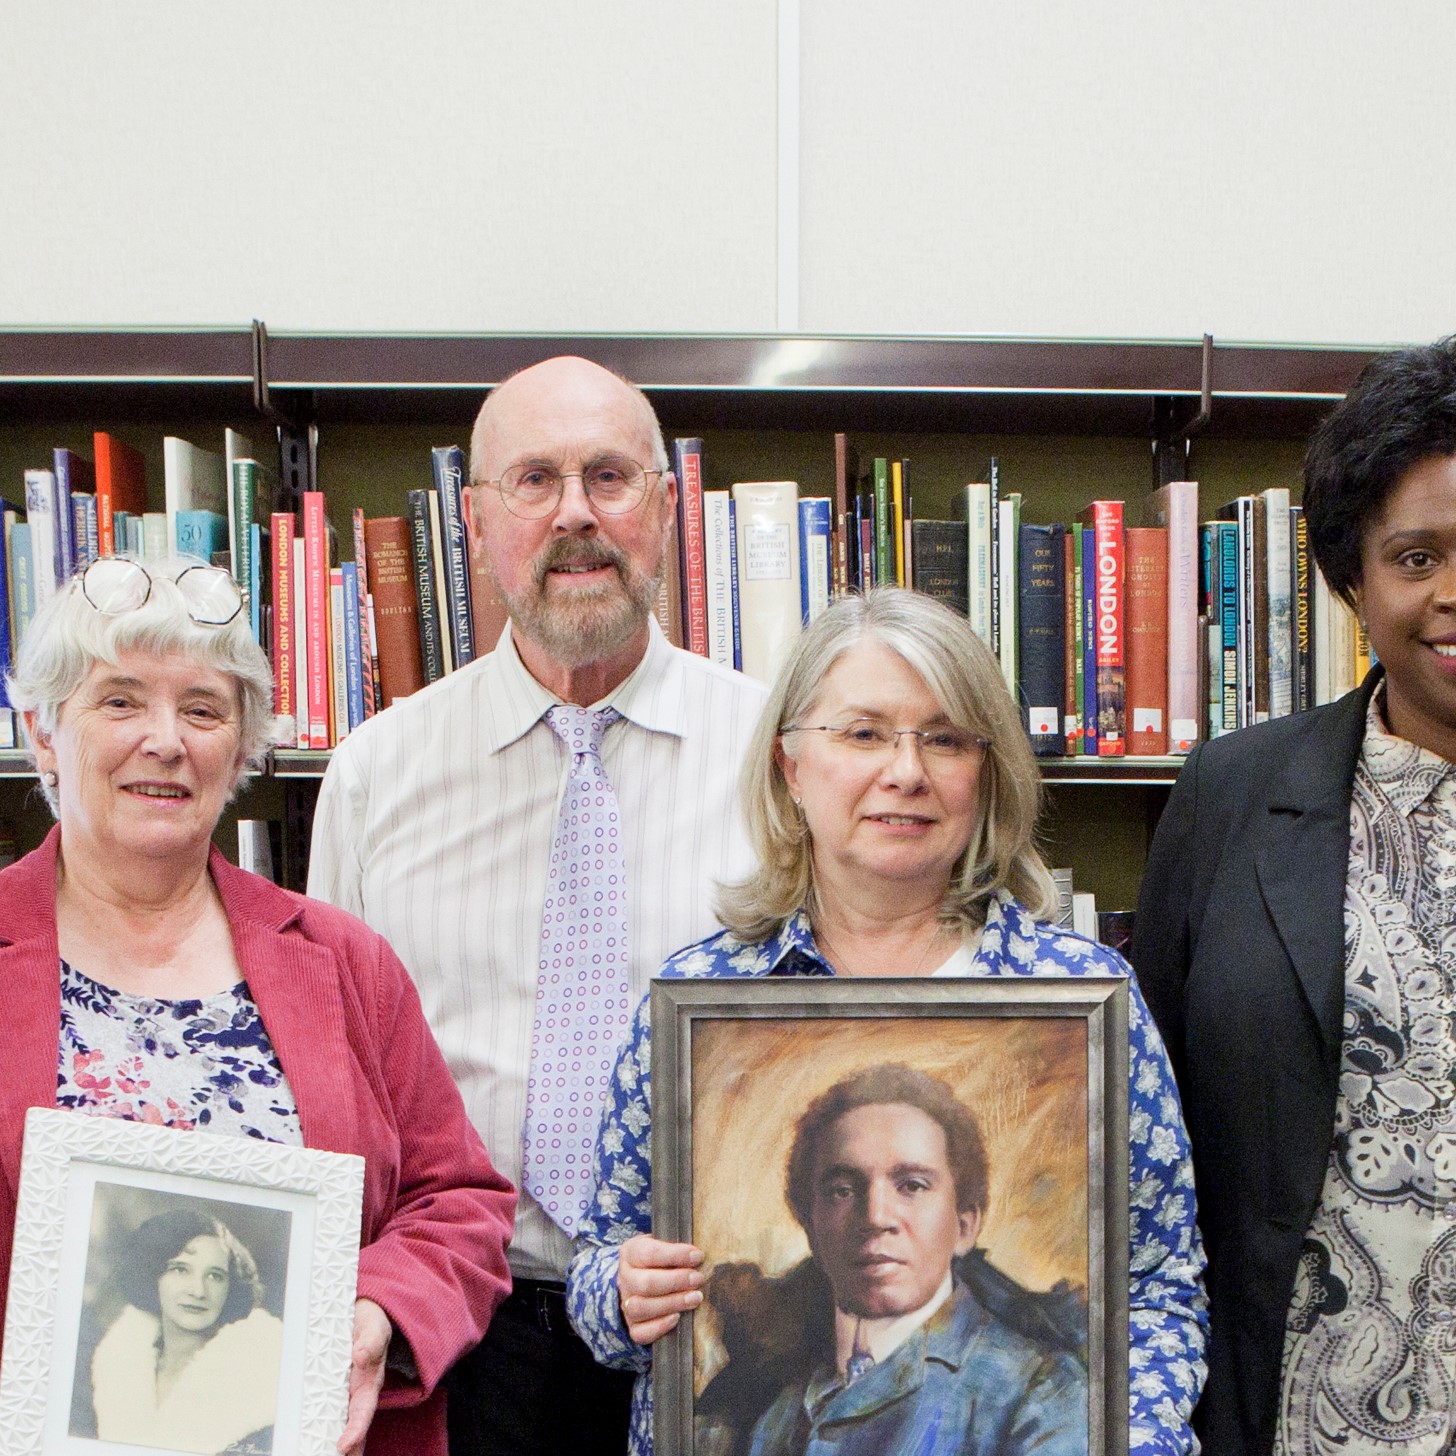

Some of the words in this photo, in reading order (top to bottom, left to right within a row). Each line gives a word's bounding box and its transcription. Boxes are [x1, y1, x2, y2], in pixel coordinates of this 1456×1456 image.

[443, 467, 462, 517] Treasures
[684, 462, 701, 547] TREASURES
[712, 500, 723, 515] The
[414, 501, 423, 518] THE
[448, 516, 462, 528] of
[181, 524, 202, 543] 50
[278, 519, 289, 566] LONDON
[310, 506, 320, 566] LITTLE-KNOWN
[415, 519, 427, 562] BRITISH
[451, 526, 463, 541] the
[713, 518, 724, 565] Collections
[1297, 518, 1307, 549] WHO
[452, 546, 467, 597] BRITISH
[688, 551, 701, 571] OF
[714, 567, 725, 577] of
[1223, 530, 1236, 588] LANDLORDS
[1298, 552, 1308, 589] OWNS
[312, 570, 321, 608] MUSEUMS
[346, 574, 355, 610] Museums
[378, 575, 407, 583] MUSEUM
[418, 565, 432, 619] MUSEUM
[689, 576, 703, 603] THE
[715, 581, 726, 602] THE
[992, 589, 1000, 601] and
[279, 570, 290, 622] MUSEUMS
[1099, 541, 1117, 654] LONDON
[1224, 592, 1236, 604] TO
[312, 610, 321, 618] IN
[313, 622, 321, 638] AND
[456, 600, 470, 653] MUSEUM
[1224, 607, 1236, 647] LONDON
[1298, 592, 1308, 654] LONDON?
[280, 626, 290, 650] AND
[347, 618, 357, 650] Galleries
[424, 620, 433, 641] AND
[715, 608, 727, 653] BRITISH
[313, 640, 322, 673] AROUND
[348, 652, 357, 661] of
[425, 641, 434, 654] ITS
[349, 662, 358, 691] London
[1224, 650, 1237, 684] SIMON
[313, 674, 322, 704] LONDON
[1224, 686, 1237, 729] JENKINS
